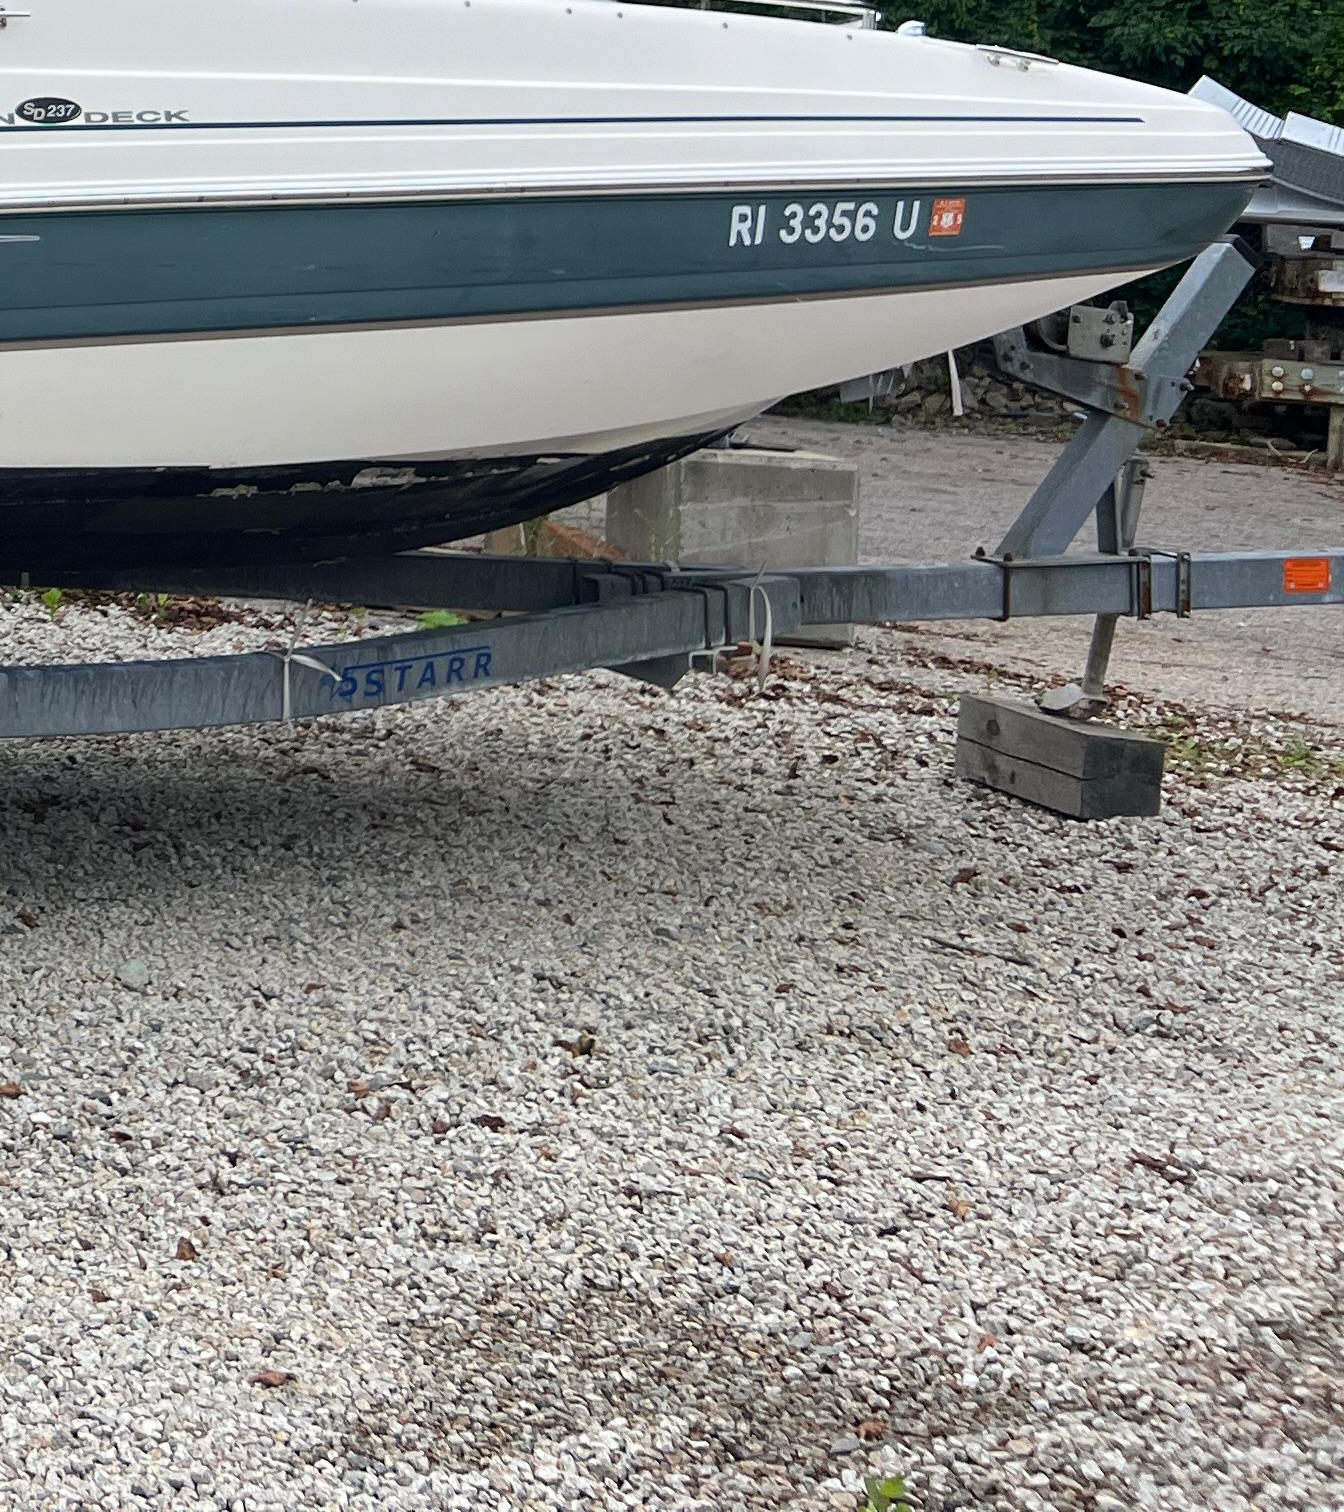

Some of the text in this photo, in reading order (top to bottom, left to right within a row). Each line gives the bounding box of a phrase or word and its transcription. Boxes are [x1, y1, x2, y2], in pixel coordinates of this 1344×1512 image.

[83, 109, 191, 124] DECK
[728, 199, 921, 247] RI 3356 U
